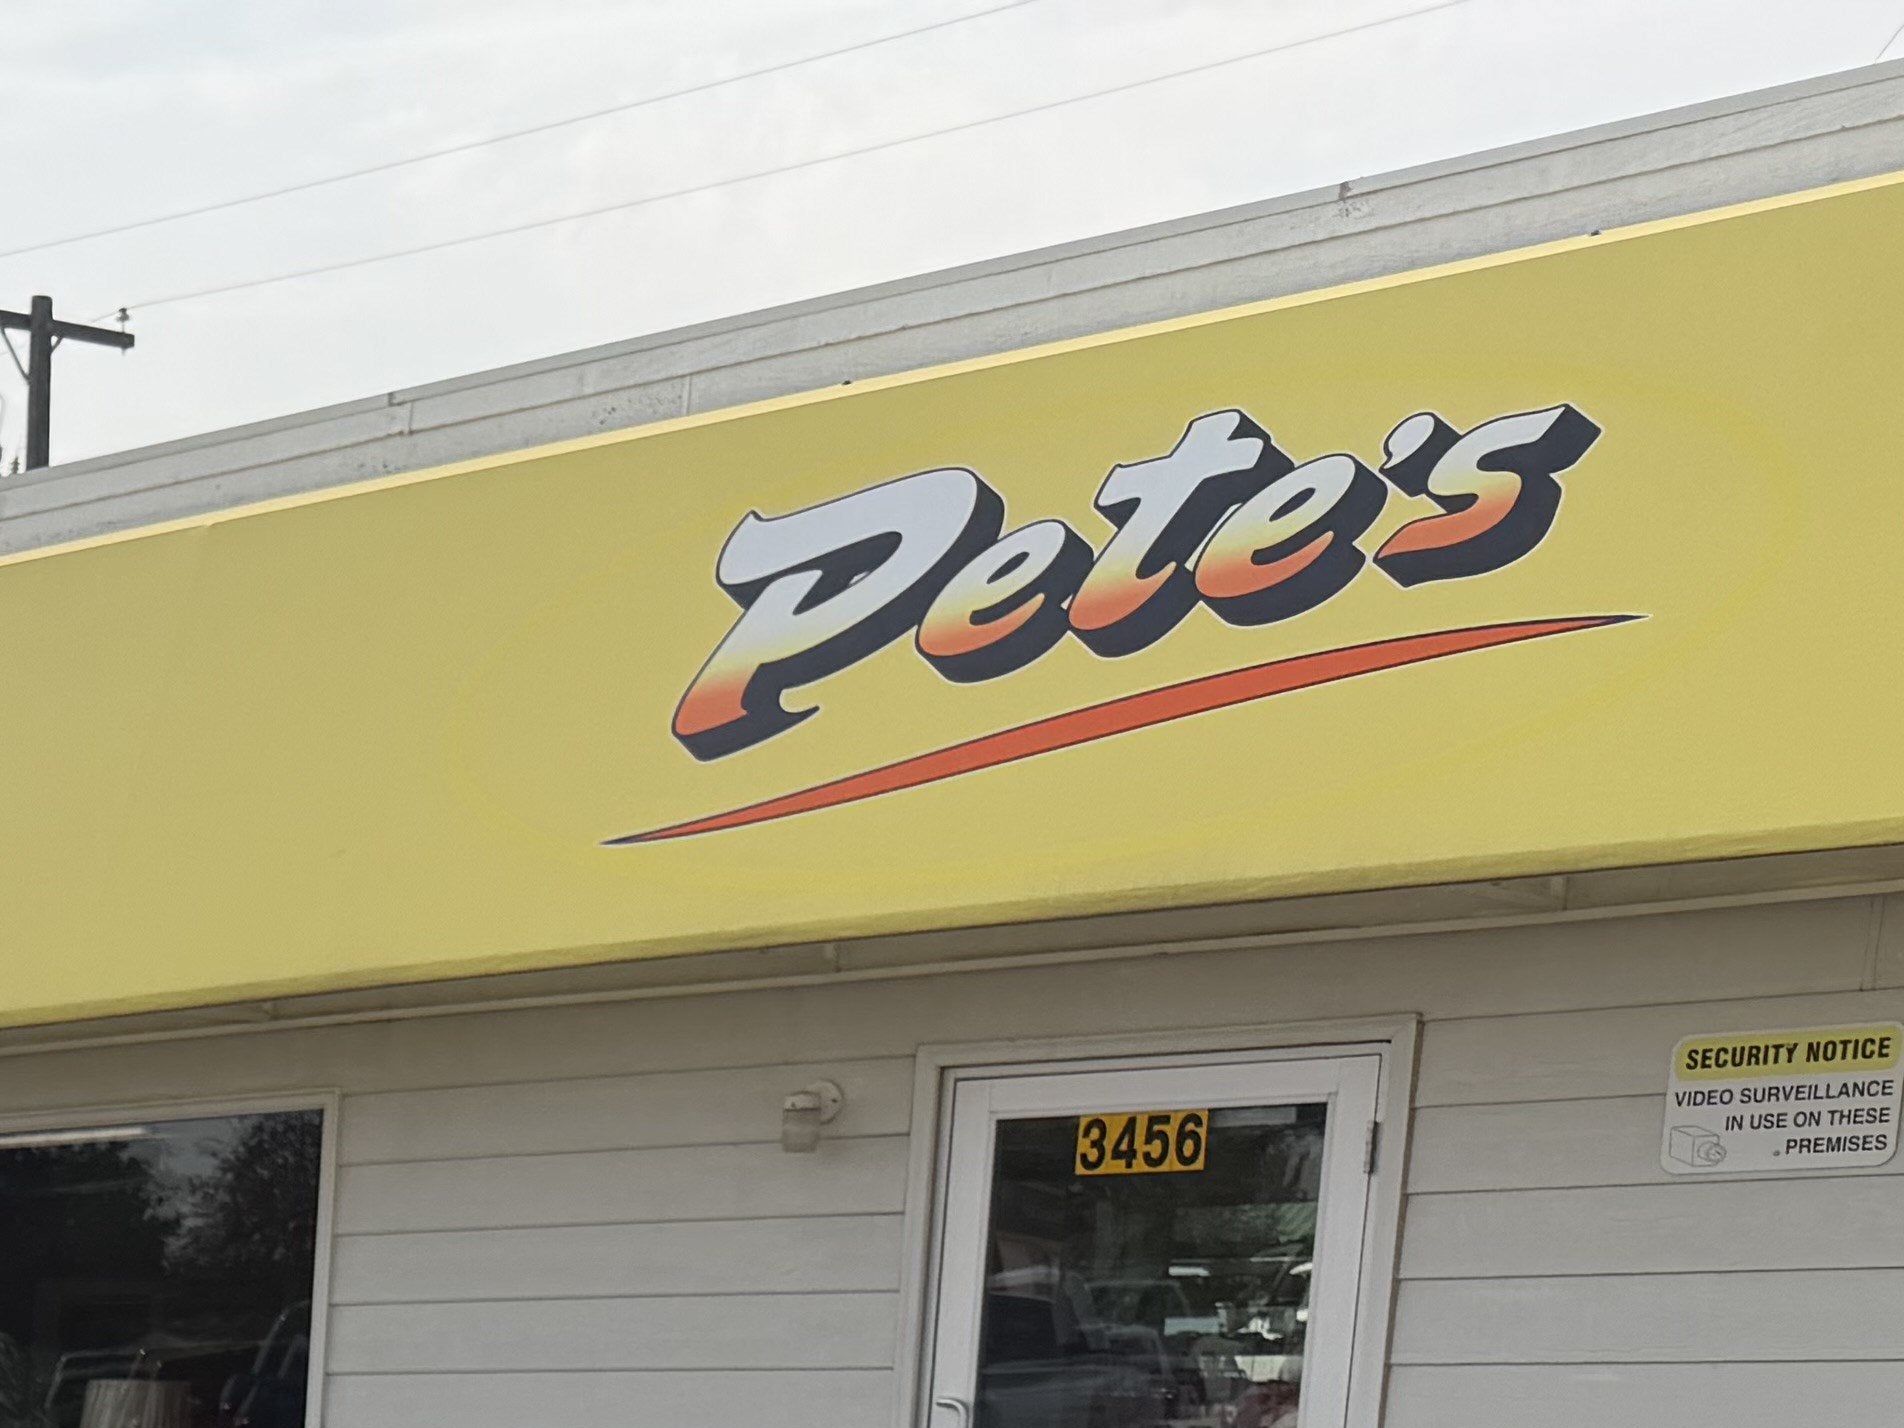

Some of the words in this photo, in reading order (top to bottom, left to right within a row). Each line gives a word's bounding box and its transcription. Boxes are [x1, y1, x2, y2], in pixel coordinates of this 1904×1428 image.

[671, 403, 1601, 760] Pete's
[1685, 1042, 1799, 1071] SECURITY
[1805, 1037, 1893, 1063] NOTICE
[1674, 1088, 1734, 1107] VIDEO
[1739, 1080, 1894, 1104] SURVEILLANCE
[1725, 1114, 1744, 1131] IN
[1749, 1112, 1788, 1130] USE
[1793, 1110, 1822, 1128] ON
[1827, 1107, 1892, 1126] THESE
[1080, 1113, 1204, 1171] 3456
[1785, 1134, 1889, 1155] PREMISES
